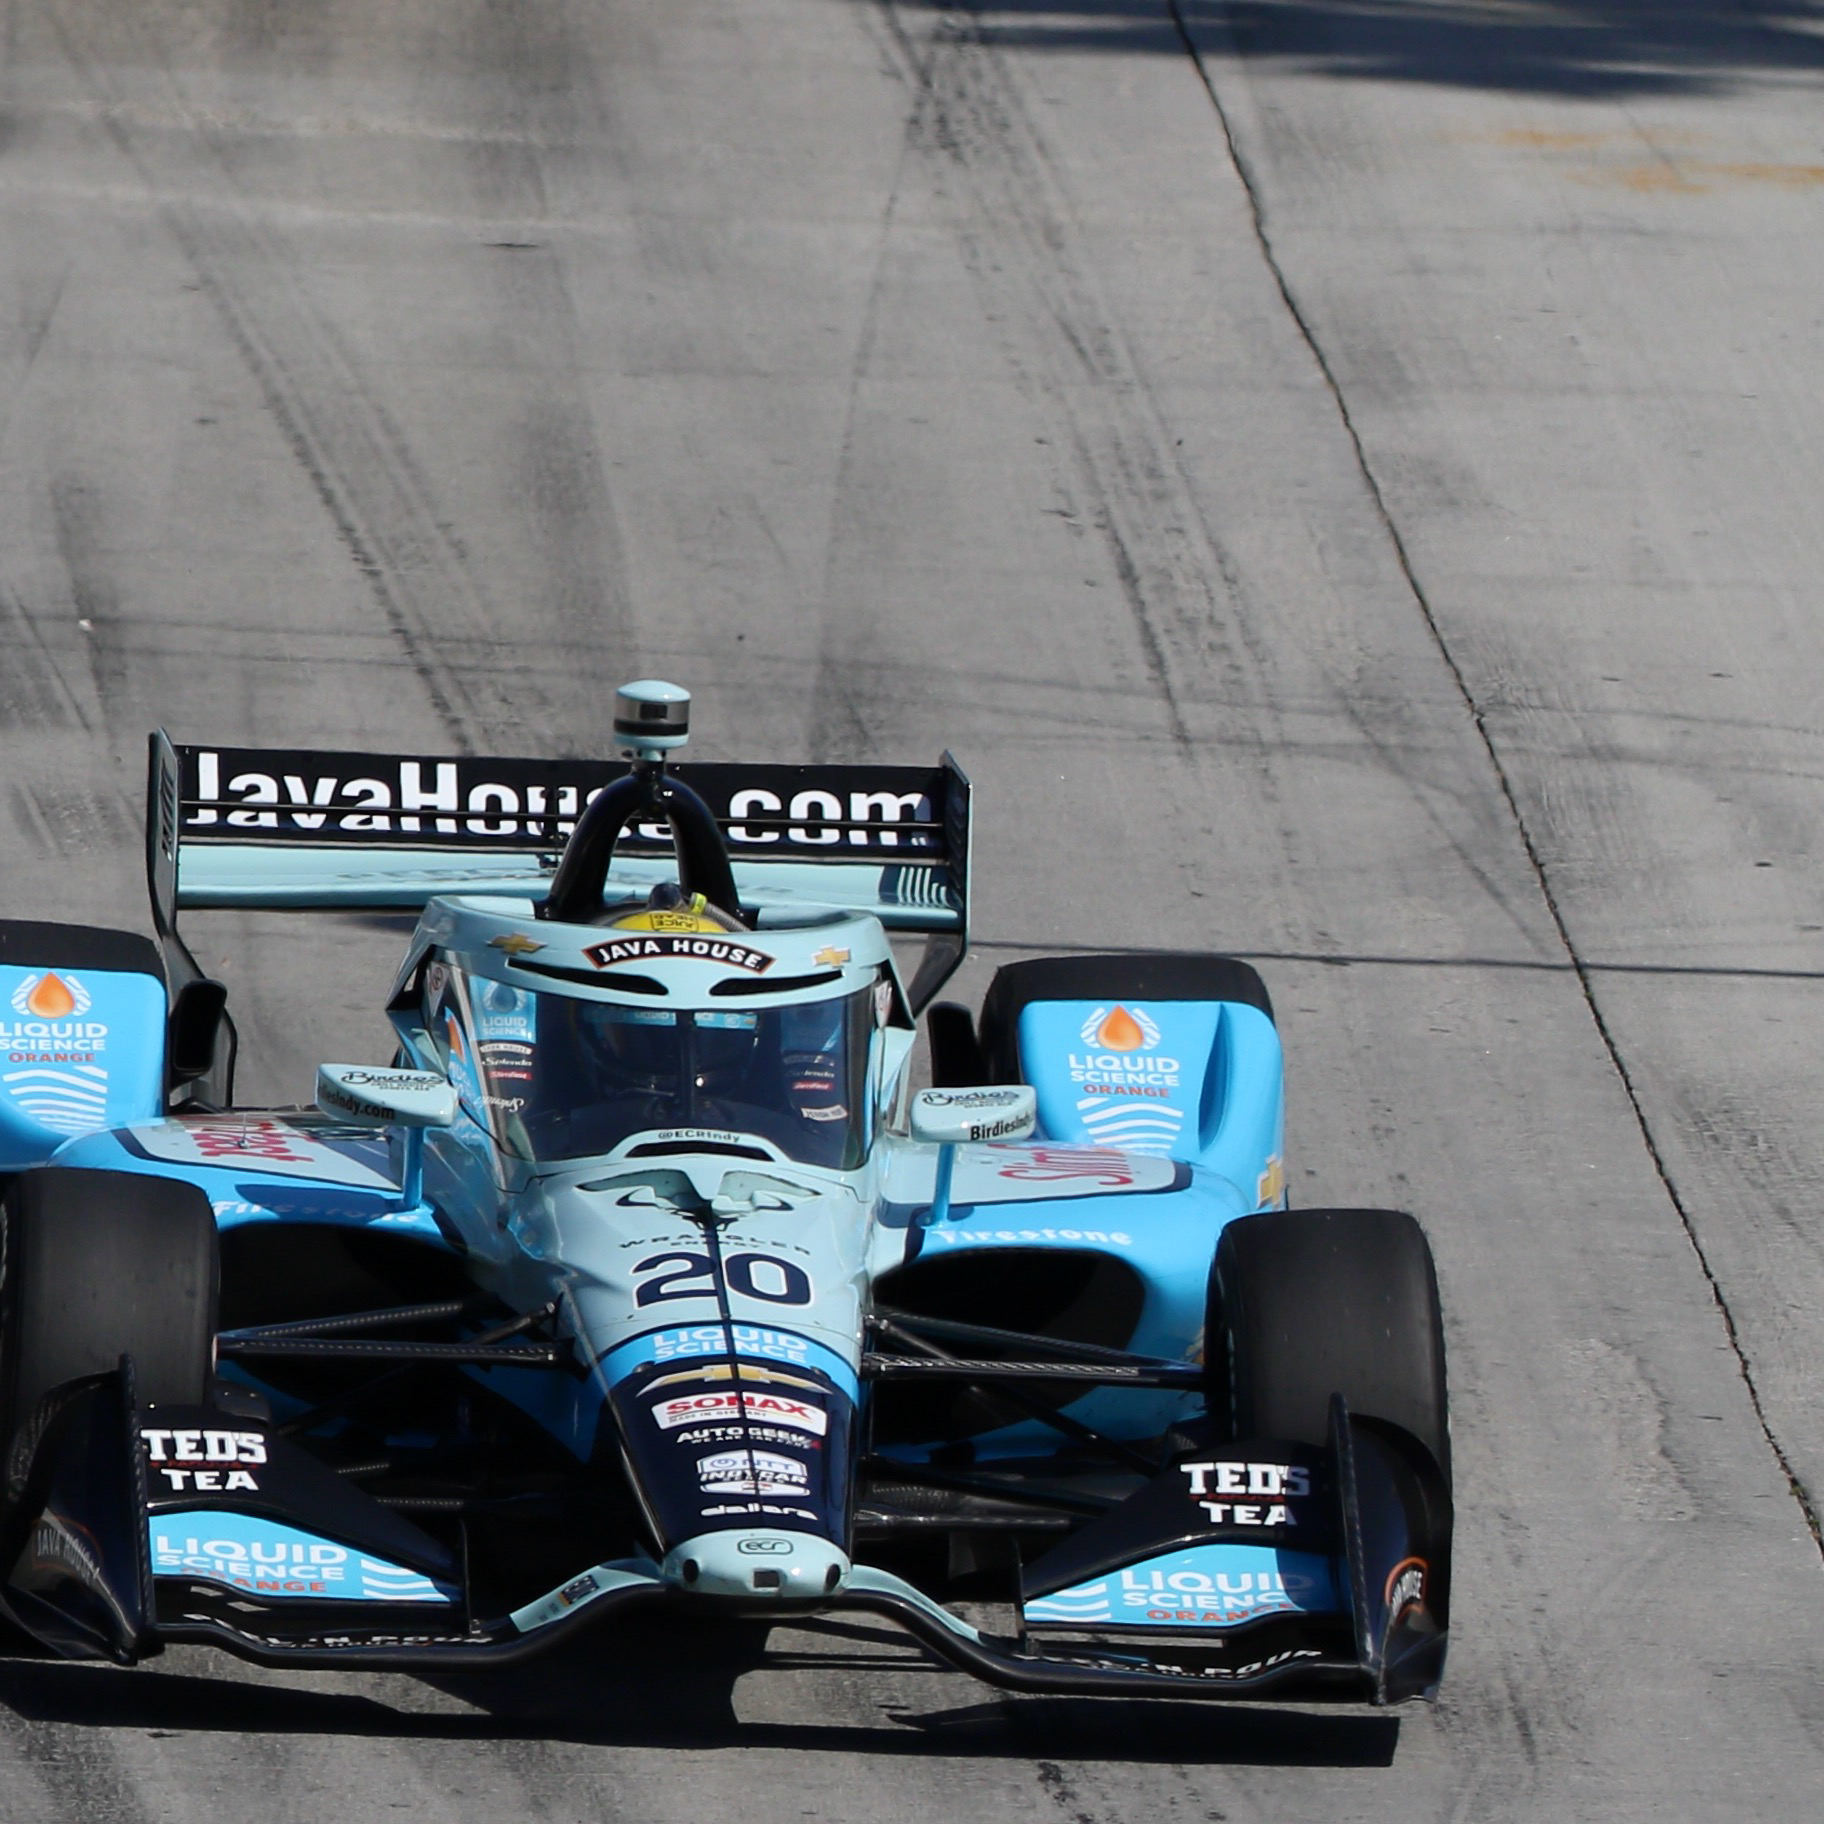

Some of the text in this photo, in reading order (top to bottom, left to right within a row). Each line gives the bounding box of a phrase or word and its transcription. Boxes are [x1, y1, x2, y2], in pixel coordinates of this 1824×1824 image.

[186, 752, 932, 848] JavaHoucom
[598, 939, 763, 969] JAVA HOUSE
[9, 1052, 95, 1063] ORANGE
[1068, 1053, 1180, 1073] LIQUID
[1070, 1069, 1180, 1087] SCIENCE
[1083, 1084, 1170, 1099] ORANGE
[657, 1129, 741, 1143] @ECRIndy
[213, 1200, 420, 1224] Firestone
[932, 1228, 1133, 1247] Firestone
[630, 1251, 815, 1310] 20
[654, 1327, 808, 1351] LIQUID
[655, 1340, 806, 1363] SCIENCE
[667, 1395, 813, 1421] SONAX
[716, 1410, 767, 1418] GERANY
[139, 1429, 268, 1464] TED'S
[676, 1427, 744, 1444] AUTO
[160, 1468, 260, 1491] TEA
[699, 1470, 808, 1485] INDYCAR
[1180, 1462, 1310, 1497] TED'S
[700, 1503, 819, 1521] dallara
[1199, 1501, 1298, 1526] TEA
[156, 1535, 349, 1566] LIQUID
[745, 1541, 785, 1551] ecr
[156, 1553, 346, 1582] SCIENCE
[1121, 1569, 1315, 1595] LIQUID
[1122, 1590, 1292, 1611] SCIENC
[1204, 1649, 1322, 1675] POUR
